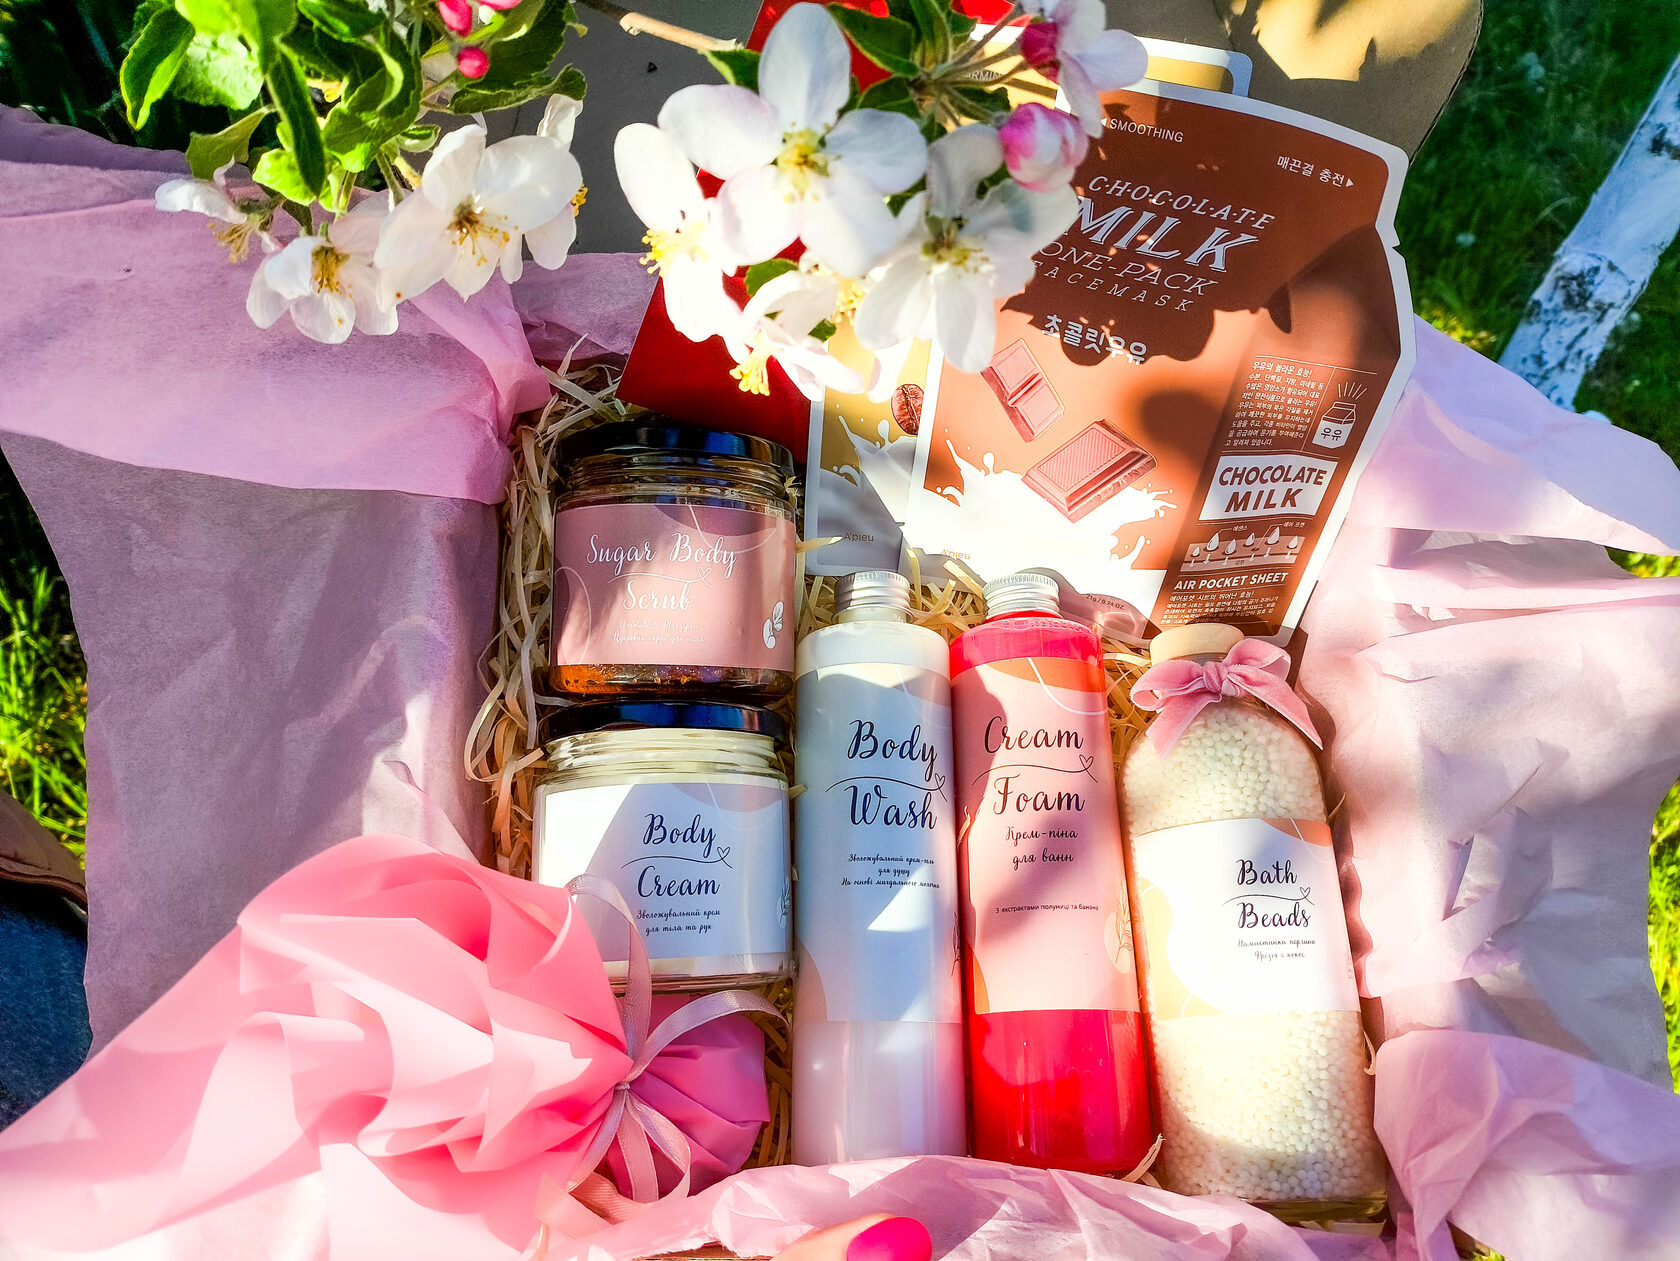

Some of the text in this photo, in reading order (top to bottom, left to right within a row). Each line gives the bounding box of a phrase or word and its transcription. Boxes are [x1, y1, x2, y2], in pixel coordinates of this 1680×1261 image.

[1109, 118, 1184, 143] SMOOTHING
[1277, 156, 1345, 187] 매끈결 충전
[1064, 195, 1259, 273] MILK
[1039, 241, 1219, 296] ONE-PACK
[1320, 427, 1342, 441] 우유
[1218, 464, 1328, 486] CHOCOLATE
[1224, 487, 1304, 513] MILK
[586, 532, 740, 579] Sugar Body
[1174, 572, 1288, 590] AIR POCKET SHEET
[623, 580, 692, 611] Scrub
[984, 715, 1085, 754] Cream
[847, 719, 938, 782] Body
[844, 784, 938, 830] Wash
[992, 773, 1085, 815] Foam
[643, 813, 717, 858] Body
[1005, 826, 1078, 847] Крем-піна
[878, 868, 890, 876] для
[1012, 847, 1075, 871] для ванн
[1235, 859, 1298, 885] Bath
[637, 865, 721, 898] Cream
[841, 877, 851, 886] На
[636, 908, 721, 922] Зволожувальний крем
[1236, 901, 1311, 929] Beads
[645, 926, 660, 936] для
[662, 924, 682, 932] тіла
[699, 923, 712, 933] рук
